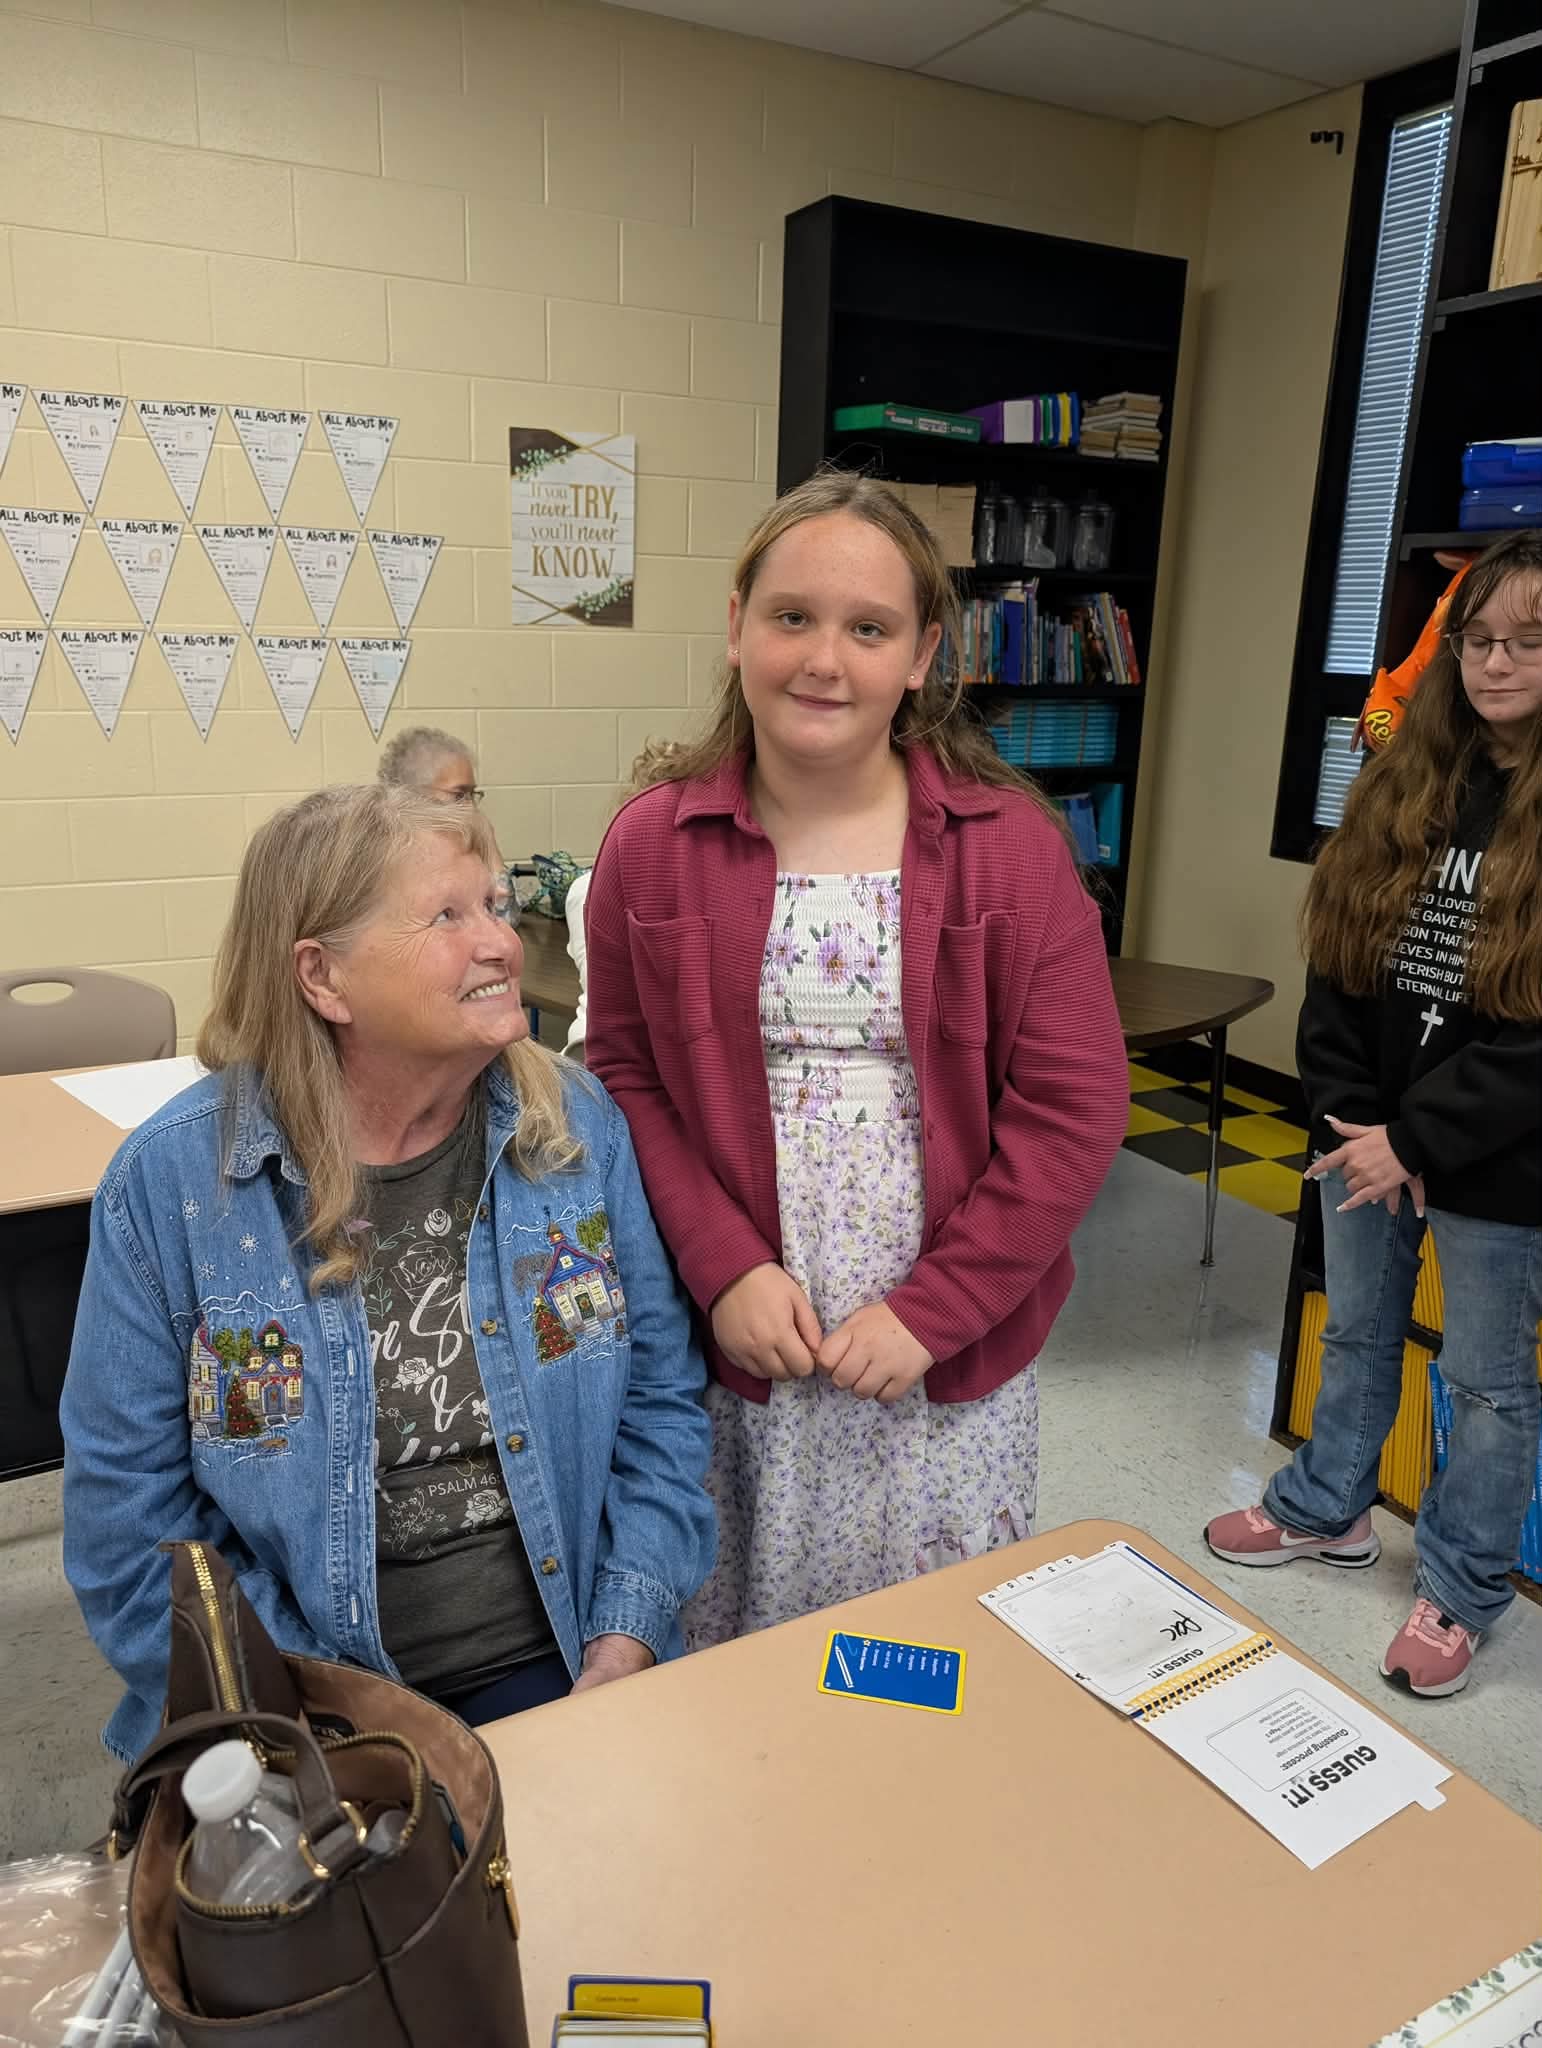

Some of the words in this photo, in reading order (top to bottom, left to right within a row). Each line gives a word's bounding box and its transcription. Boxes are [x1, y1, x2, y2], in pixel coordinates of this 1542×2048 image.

[2, 384, 22, 399] Me
[40, 392, 60, 405] ALL
[64, 394, 103, 410] About
[103, 397, 121, 410] Me
[140, 403, 161, 416] ALL
[163, 405, 198, 418] About
[200, 406, 217, 419] Me
[234, 409, 252, 420] ALL
[255, 410, 287, 424] About
[289, 413, 307, 425] Me
[324, 414, 342, 425] ALL
[344, 416, 374, 429] About
[376, 418, 393, 431] Me
[544, 486, 567, 500] you
[530, 503, 571, 516] never
[569, 484, 618, 524] TRY,
[0, 509, 20, 522] ALL
[24, 511, 59, 525] About
[63, 513, 81, 526] Me
[102, 520, 121, 532] ALL
[125, 521, 158, 534] About
[160, 522, 179, 535] Me
[201, 527, 219, 538] ALL
[223, 527, 256, 539] About
[257, 527, 274, 538] Me
[531, 523, 573, 543] you'll
[577, 528, 619, 542] never
[285, 529, 304, 540] ALL
[306, 530, 337, 544] About
[339, 532, 355, 544] Me
[372, 533, 388, 543] ALL
[391, 535, 420, 547] About
[423, 537, 437, 548] Me
[532, 545, 616, 579] KNOW
[0, 631, 22, 643] out
[26, 629, 44, 643] Me
[61, 631, 81, 643] ALL
[83, 630, 119, 644] About
[121, 630, 139, 643] Me
[161, 635, 180, 646] ALL
[183, 634, 216, 647] About
[218, 635, 235, 647] Me
[257, 637, 274, 650] ALL
[276, 638, 308, 651] About
[310, 638, 326, 651] Me
[341, 639, 358, 650] ALL
[360, 639, 388, 652] About
[390, 639, 407, 652] Me
[1418, 892, 1435, 904] SO
[1438, 896, 1476, 913] LOVED
[1423, 910, 1459, 928] GAVE
[1459, 917, 1477, 932] HIS
[1432, 930, 1462, 948] THAT
[1436, 951, 1448, 962] IN
[1400, 962, 1444, 979] PERISH
[1444, 971, 1465, 985] BUT
[1397, 978, 1444, 999] ETERNAL
[428, 1478, 477, 1496] PSALM
[1164, 1649, 1204, 1671] GUESS
[1147, 1668, 1166, 1679] IT!
[1310, 1728, 1349, 1752] Guessing
[1308, 1745, 1377, 1791] GUESS
[1281, 1784, 1315, 1809] IT!
